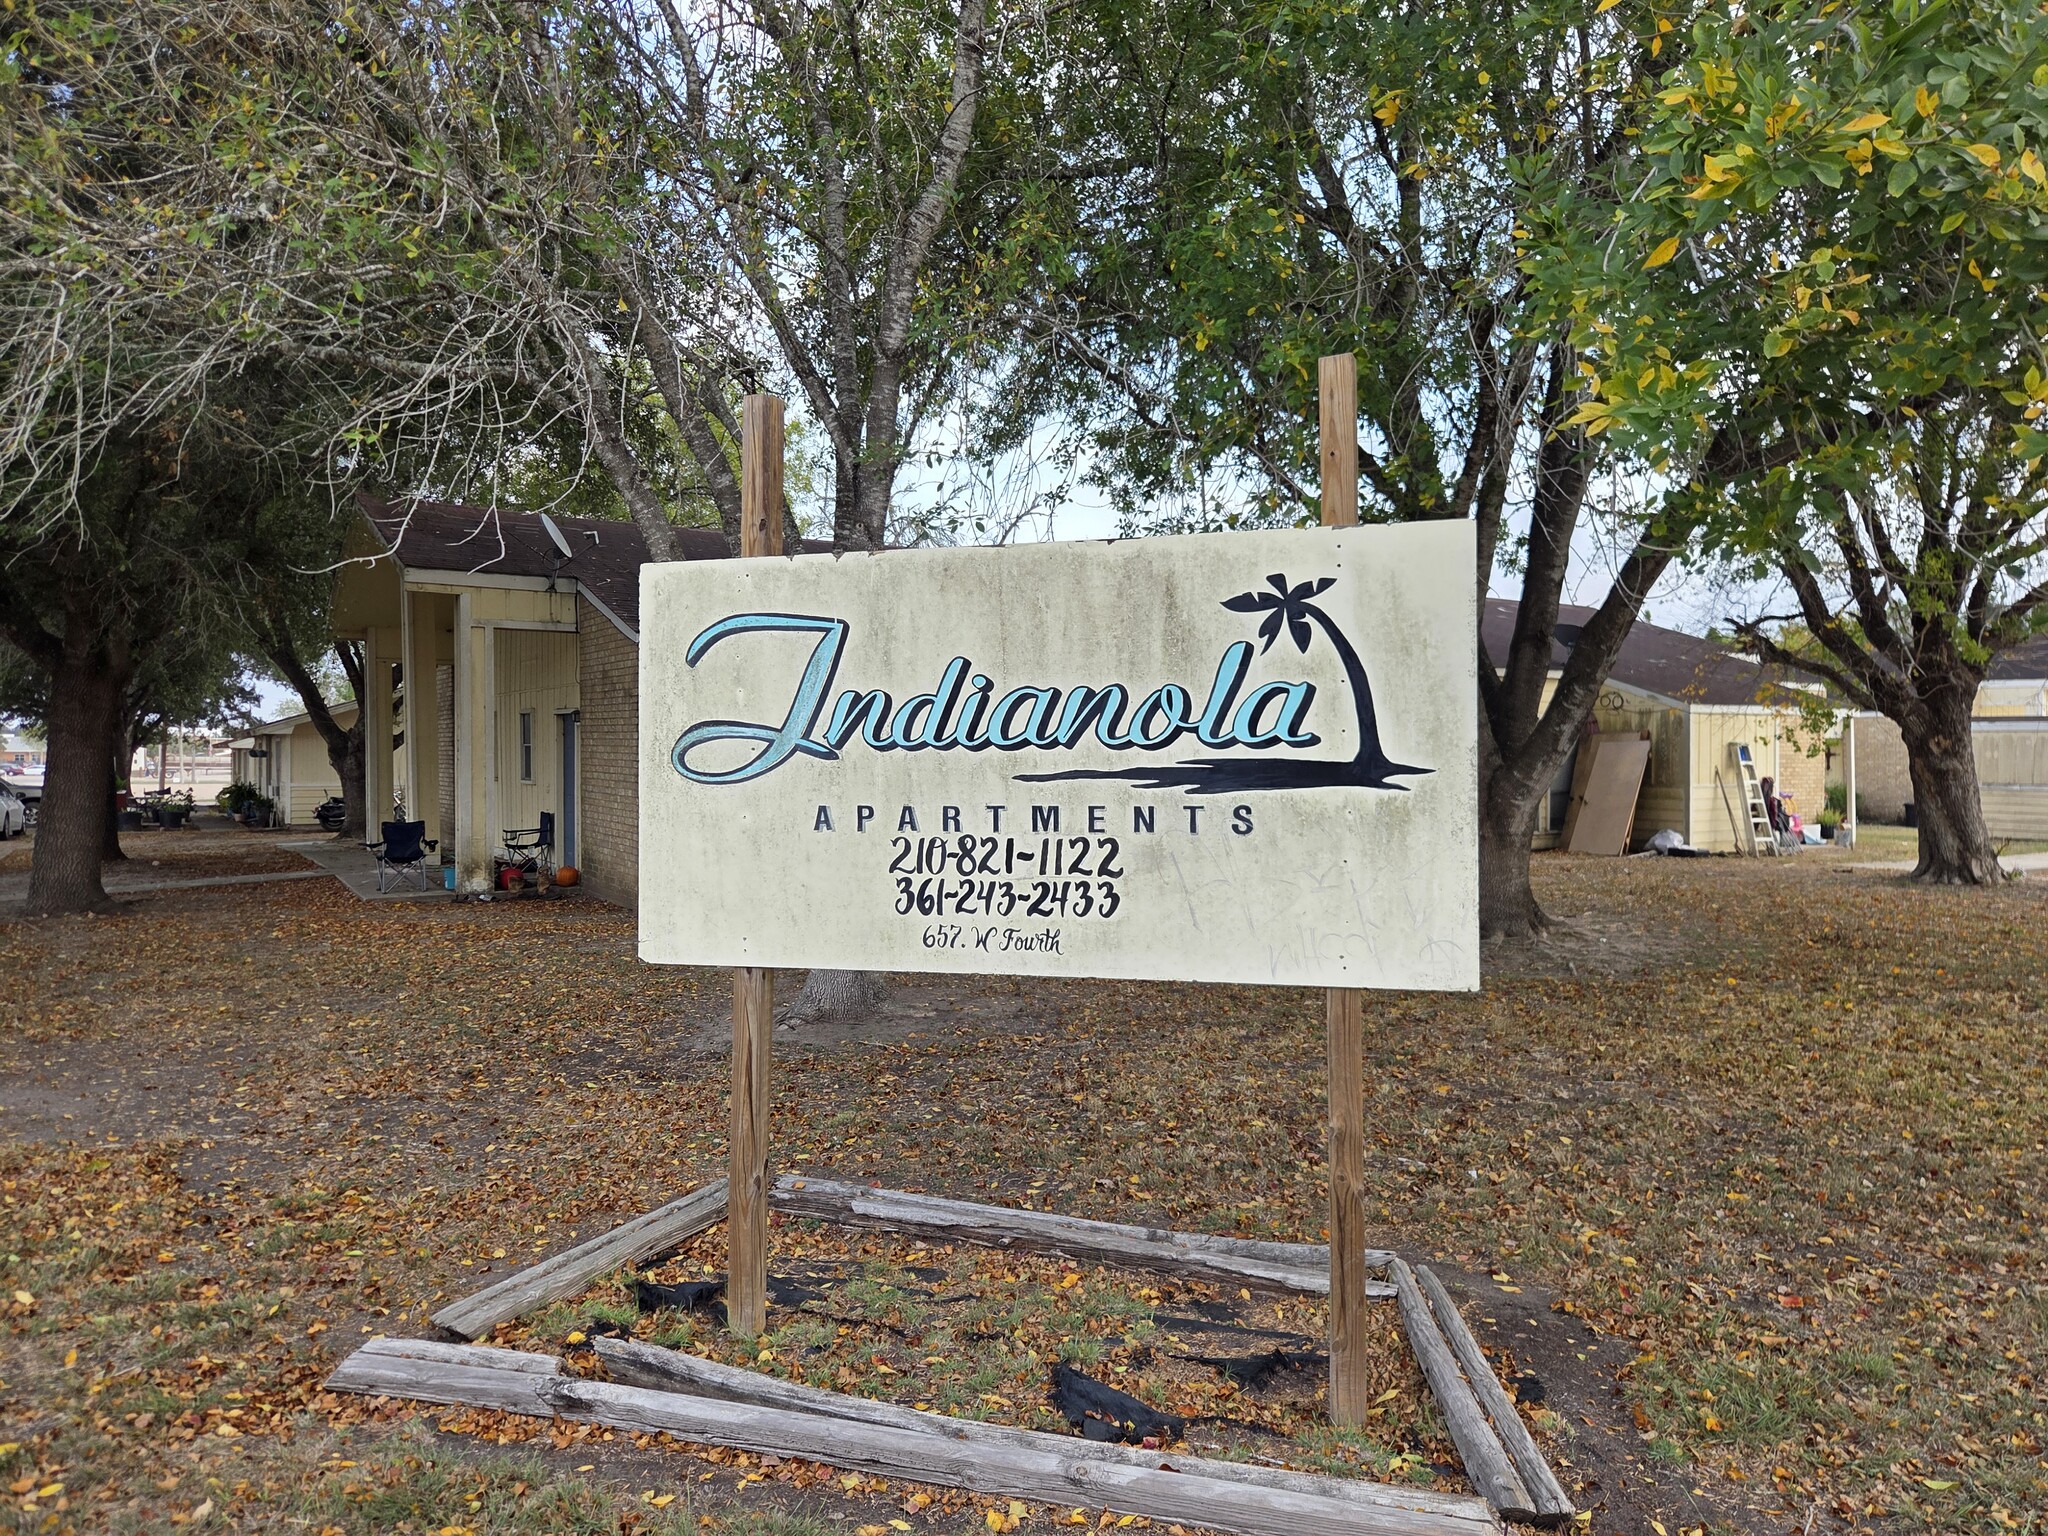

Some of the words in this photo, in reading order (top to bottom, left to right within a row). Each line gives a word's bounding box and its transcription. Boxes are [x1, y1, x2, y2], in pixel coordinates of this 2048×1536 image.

[672, 613, 1321, 784] Indianola
[813, 804, 1255, 836] APARTMENTS
[888, 833, 1125, 877] 210-821-1122
[894, 876, 1121, 919] 361-243-2433
[921, 923, 966, 949] 657.
[973, 926, 998, 950] W
[1001, 926, 1065, 956] Fourth
